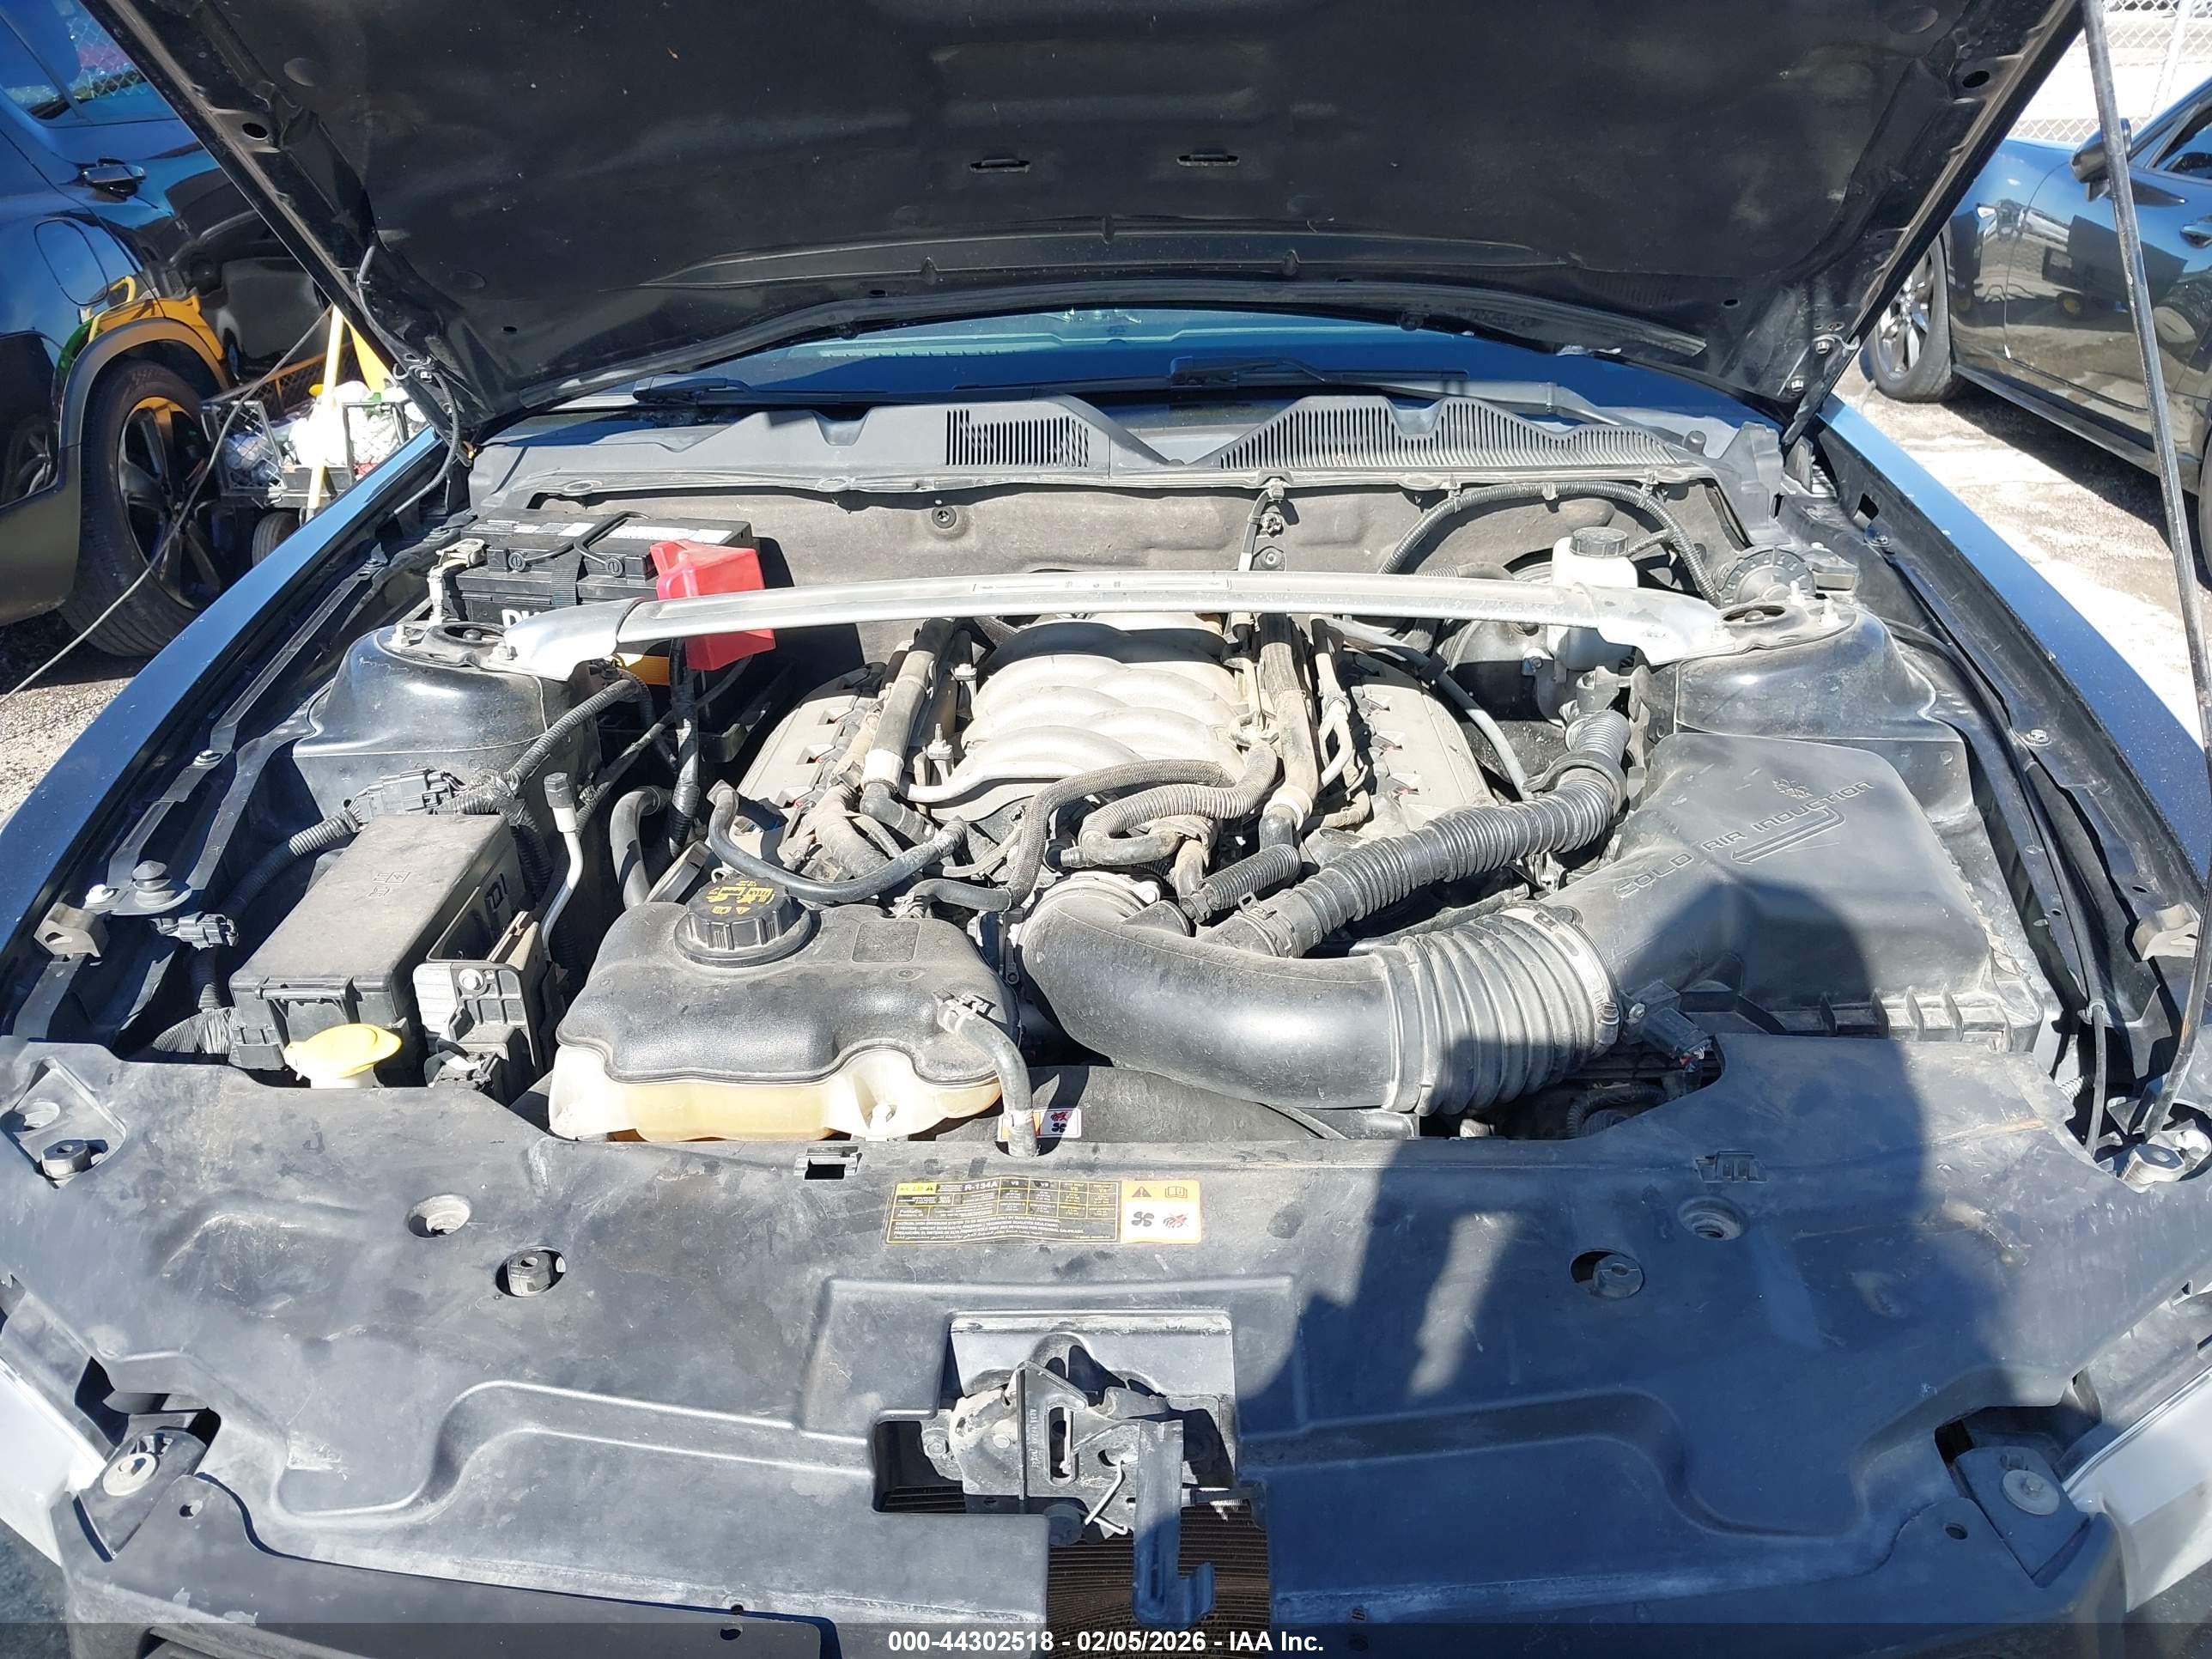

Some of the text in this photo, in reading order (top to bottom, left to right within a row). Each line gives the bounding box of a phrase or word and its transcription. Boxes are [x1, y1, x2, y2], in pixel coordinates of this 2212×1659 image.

[1701, 830, 1747, 853] AIR
[1751, 781, 1875, 833] INDUCTION
[964, 1181, 998, 1191] R-134A
